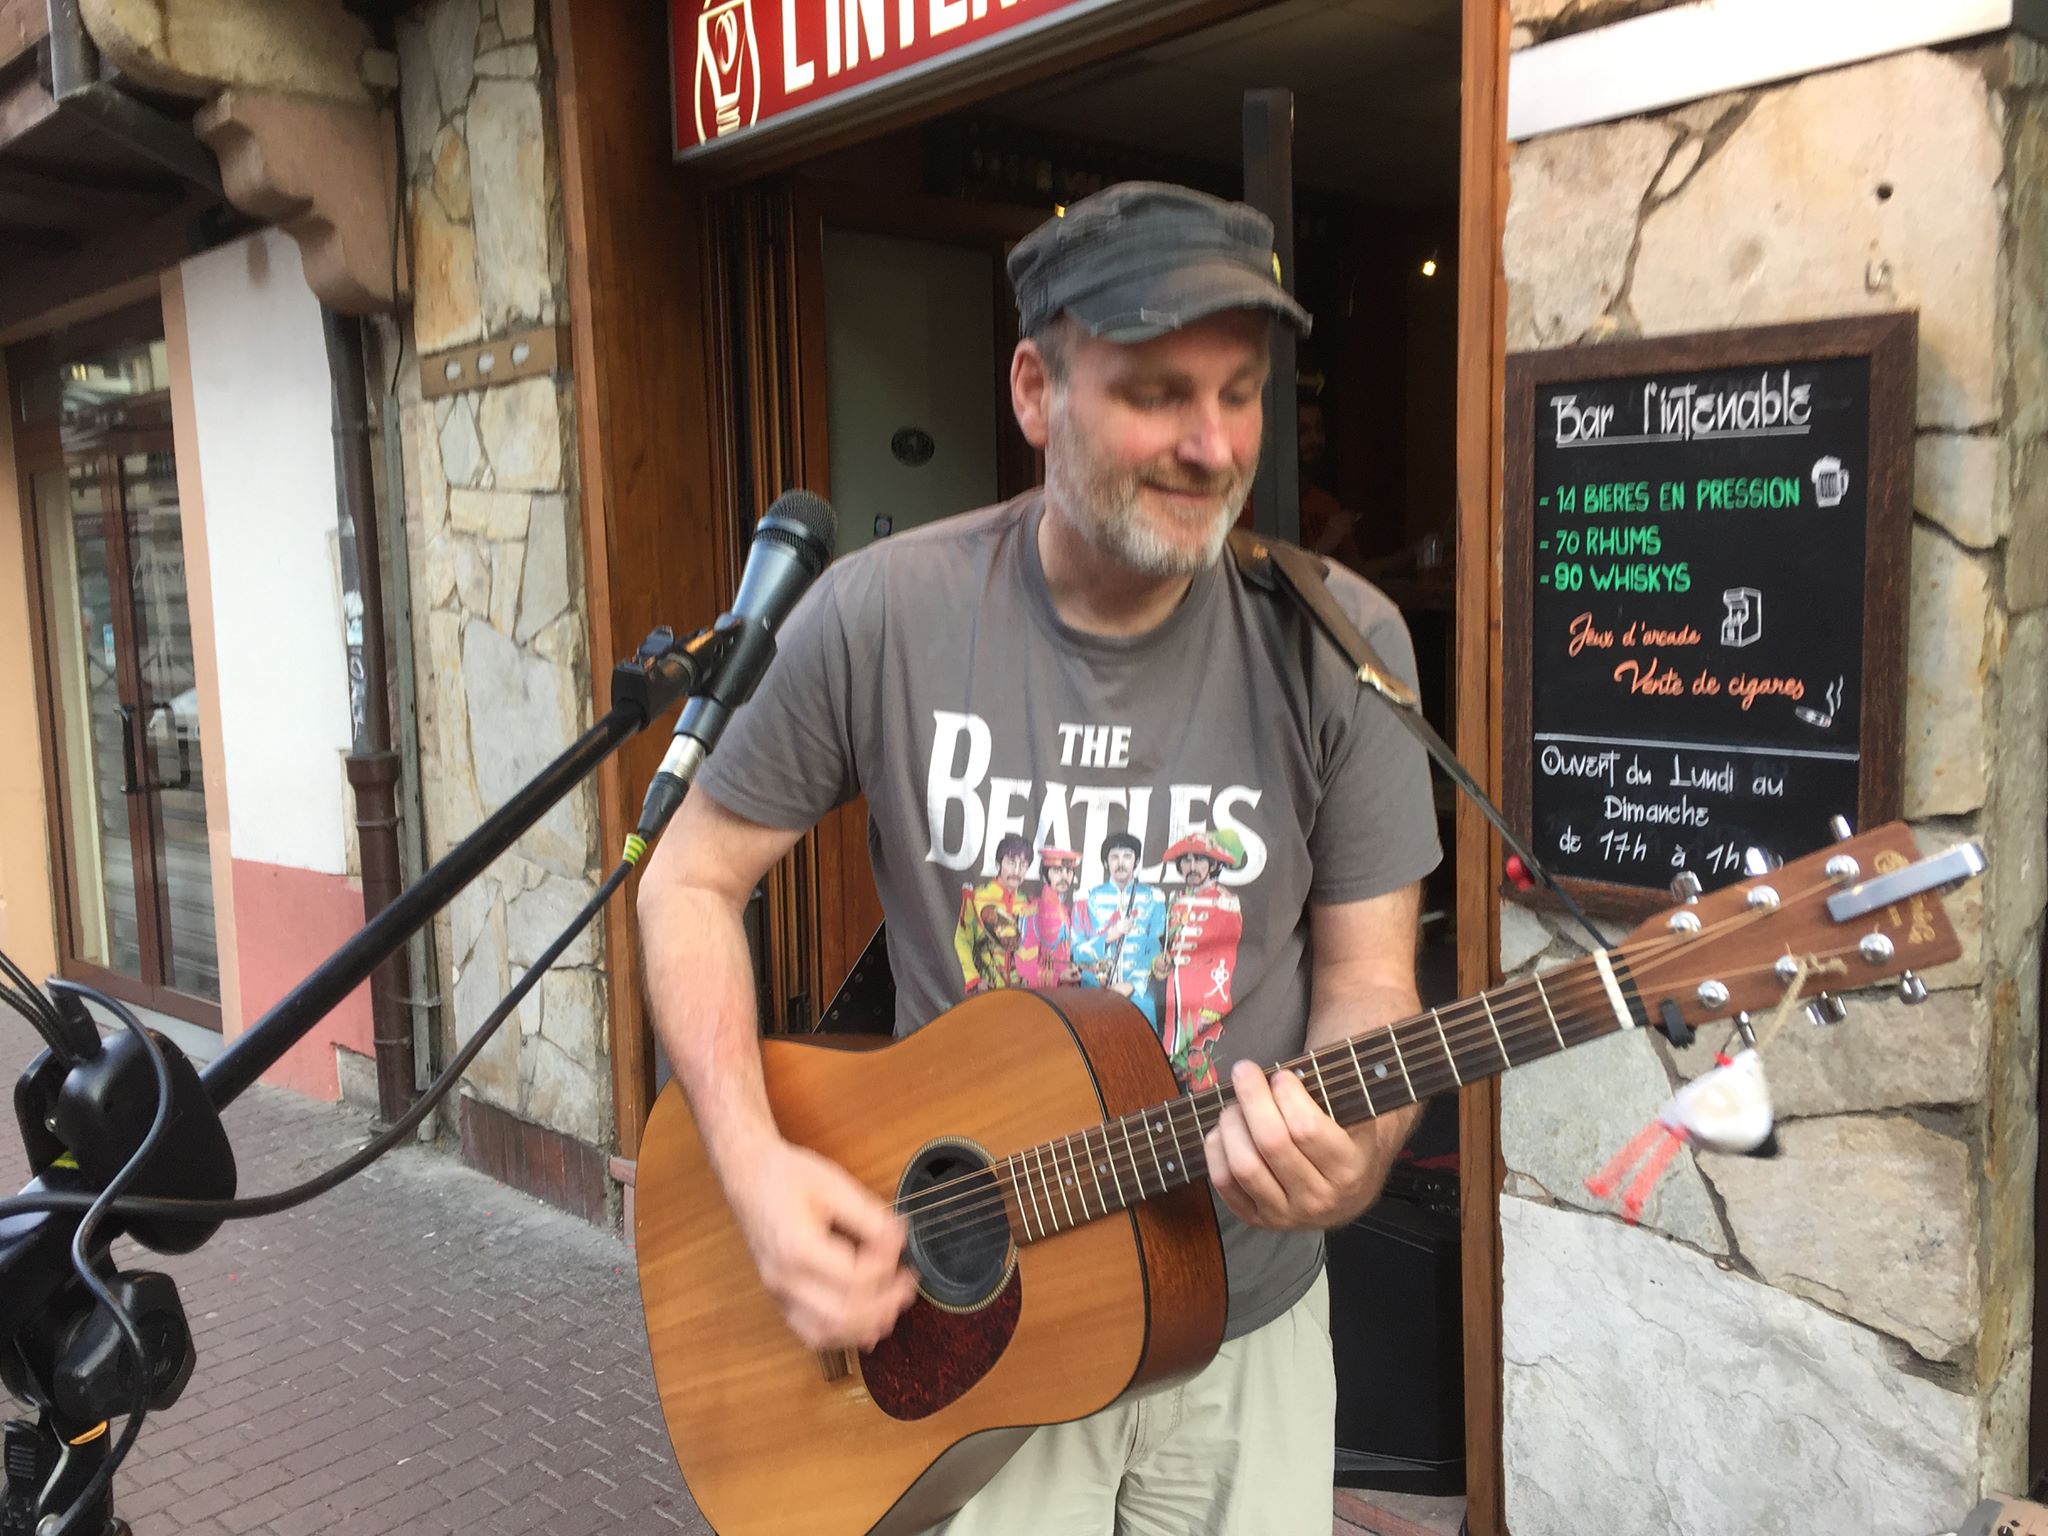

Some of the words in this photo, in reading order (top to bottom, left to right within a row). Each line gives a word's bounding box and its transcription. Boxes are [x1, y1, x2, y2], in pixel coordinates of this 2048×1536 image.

[1550, 394, 1614, 443] Bar
[1557, 485, 1576, 514] 14
[1584, 481, 1650, 514] BIERES
[1659, 481, 1685, 512] EN
[1697, 476, 1801, 512] PRESSION
[1556, 529, 1580, 556] 70
[1586, 525, 1662, 556] RHUMS
[1589, 562, 1692, 593] WHISKYS
[1569, 612, 1614, 658] Jeux
[1622, 620, 1701, 648] d'arcade
[1613, 656, 1684, 695] Vente
[1692, 668, 1721, 696] de
[1728, 672, 1805, 712] cigares
[1058, 722, 1132, 769] THE
[1541, 744, 1621, 788] Ouvert
[1626, 753, 1652, 786] du
[1670, 753, 1734, 794] Lundi
[1752, 775, 1784, 797] au
[925, 710, 1268, 898] BEATLES
[1604, 794, 1710, 827] Dimanche
[1559, 825, 1582, 854] de
[1600, 829, 1647, 864] 17h
[1671, 844, 1686, 868] à
